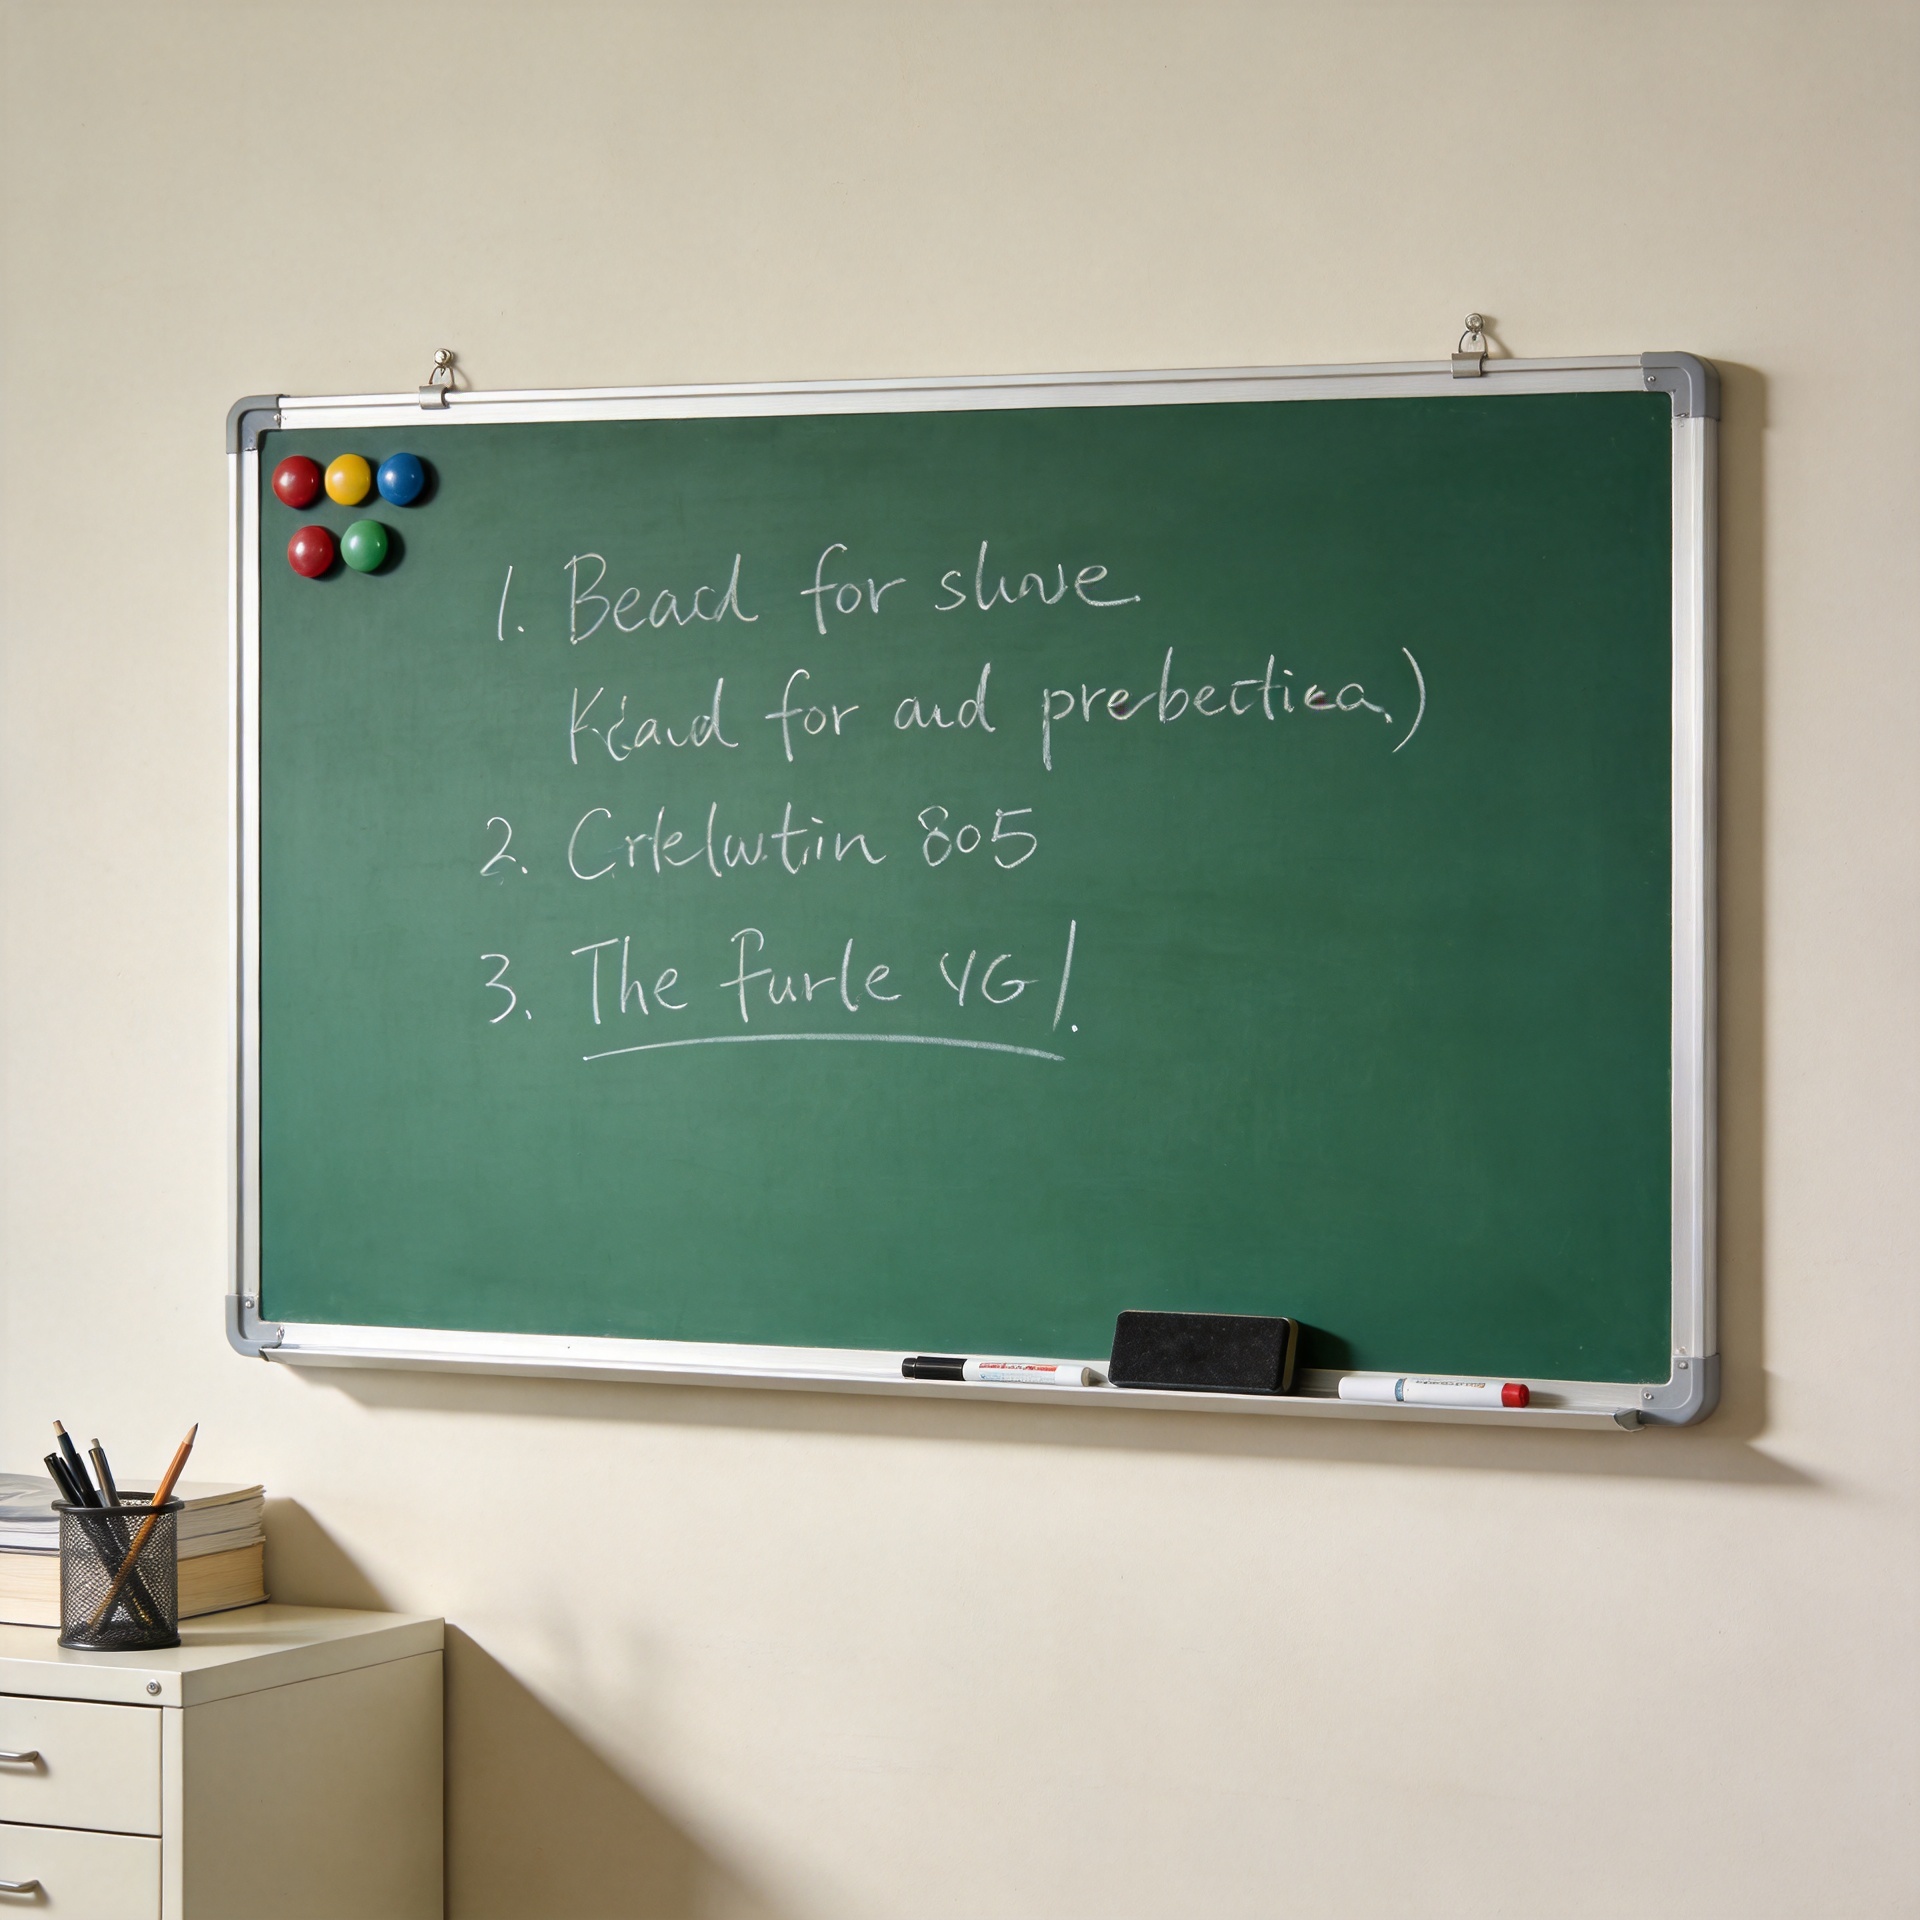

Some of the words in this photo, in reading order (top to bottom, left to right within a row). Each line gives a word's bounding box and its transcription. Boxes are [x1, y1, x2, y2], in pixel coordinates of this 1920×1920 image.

[497, 564, 526, 642] 1.
[800, 543, 907, 636] for
[764, 668, 860, 763] for
[479, 816, 529, 880] 2.
[480, 953, 533, 1024] 3.
[570, 935, 689, 1026] The
